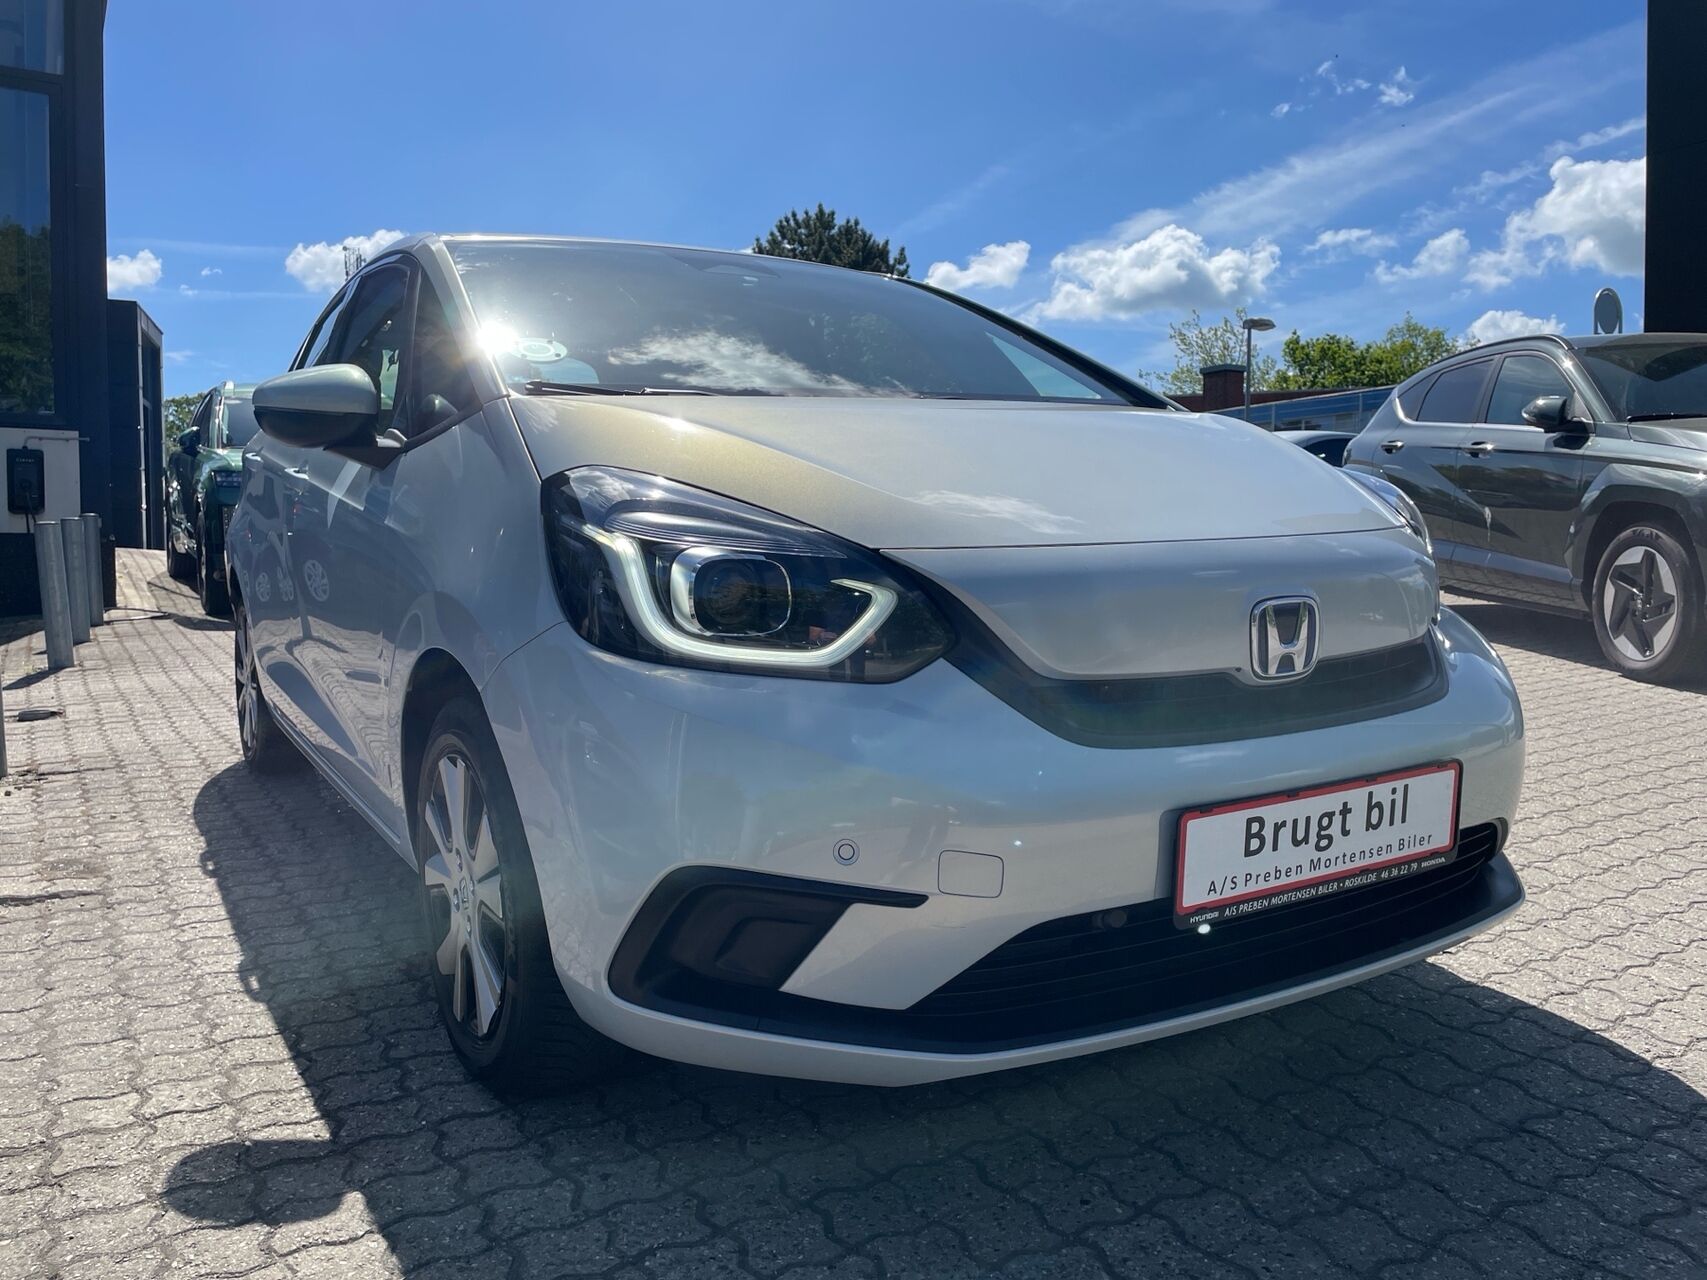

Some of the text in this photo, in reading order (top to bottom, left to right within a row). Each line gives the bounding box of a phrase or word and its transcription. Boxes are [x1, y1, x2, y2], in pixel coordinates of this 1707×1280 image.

[1243, 784, 1409, 858] Brugt bil
[1207, 833, 1432, 896] A/S Preben Mortensen Biler
[1224, 905, 1237, 917] A/S
[1238, 899, 1269, 914] PREBEN
[1270, 887, 1316, 905] MORTENSEN
[1317, 882, 1338, 895] BILER
[1344, 872, 1377, 888] ROSKILDE
[1381, 869, 1389, 879] 46
[1400, 864, 1408, 875] 22
[1410, 861, 1418, 873] 79
[1421, 856, 1446, 868] HONDA
